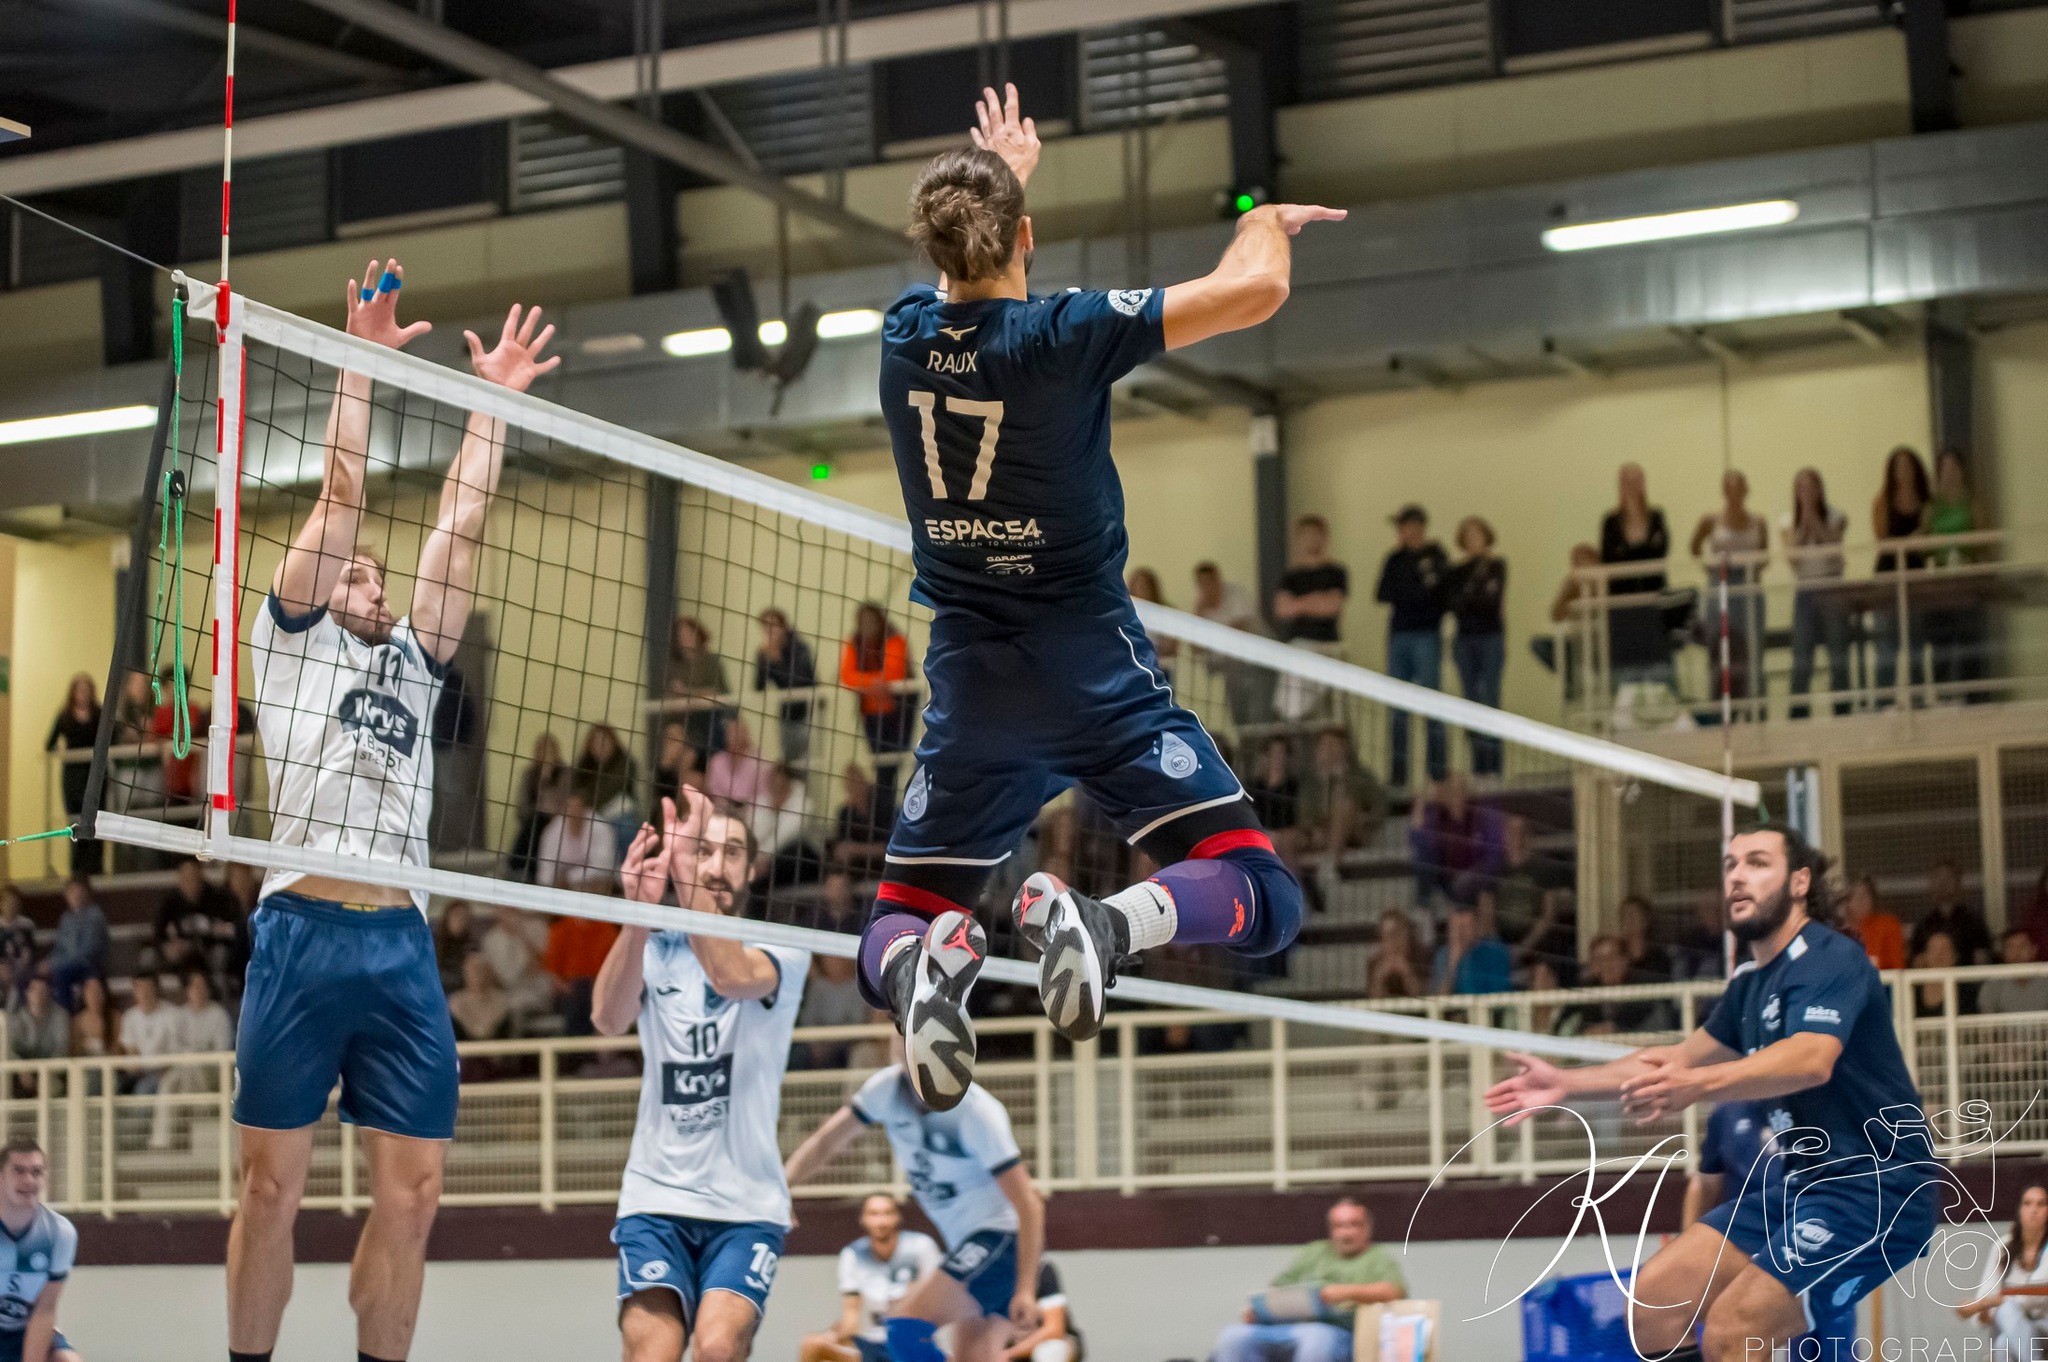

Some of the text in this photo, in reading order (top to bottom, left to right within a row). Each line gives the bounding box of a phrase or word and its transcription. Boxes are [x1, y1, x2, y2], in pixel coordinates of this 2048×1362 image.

[926, 350, 978, 374] RAUX
[908, 389, 1004, 500] 17
[924, 518, 1043, 541] ESPACE4
[376, 645, 402, 688] 11
[686, 1022, 719, 1059] 10
